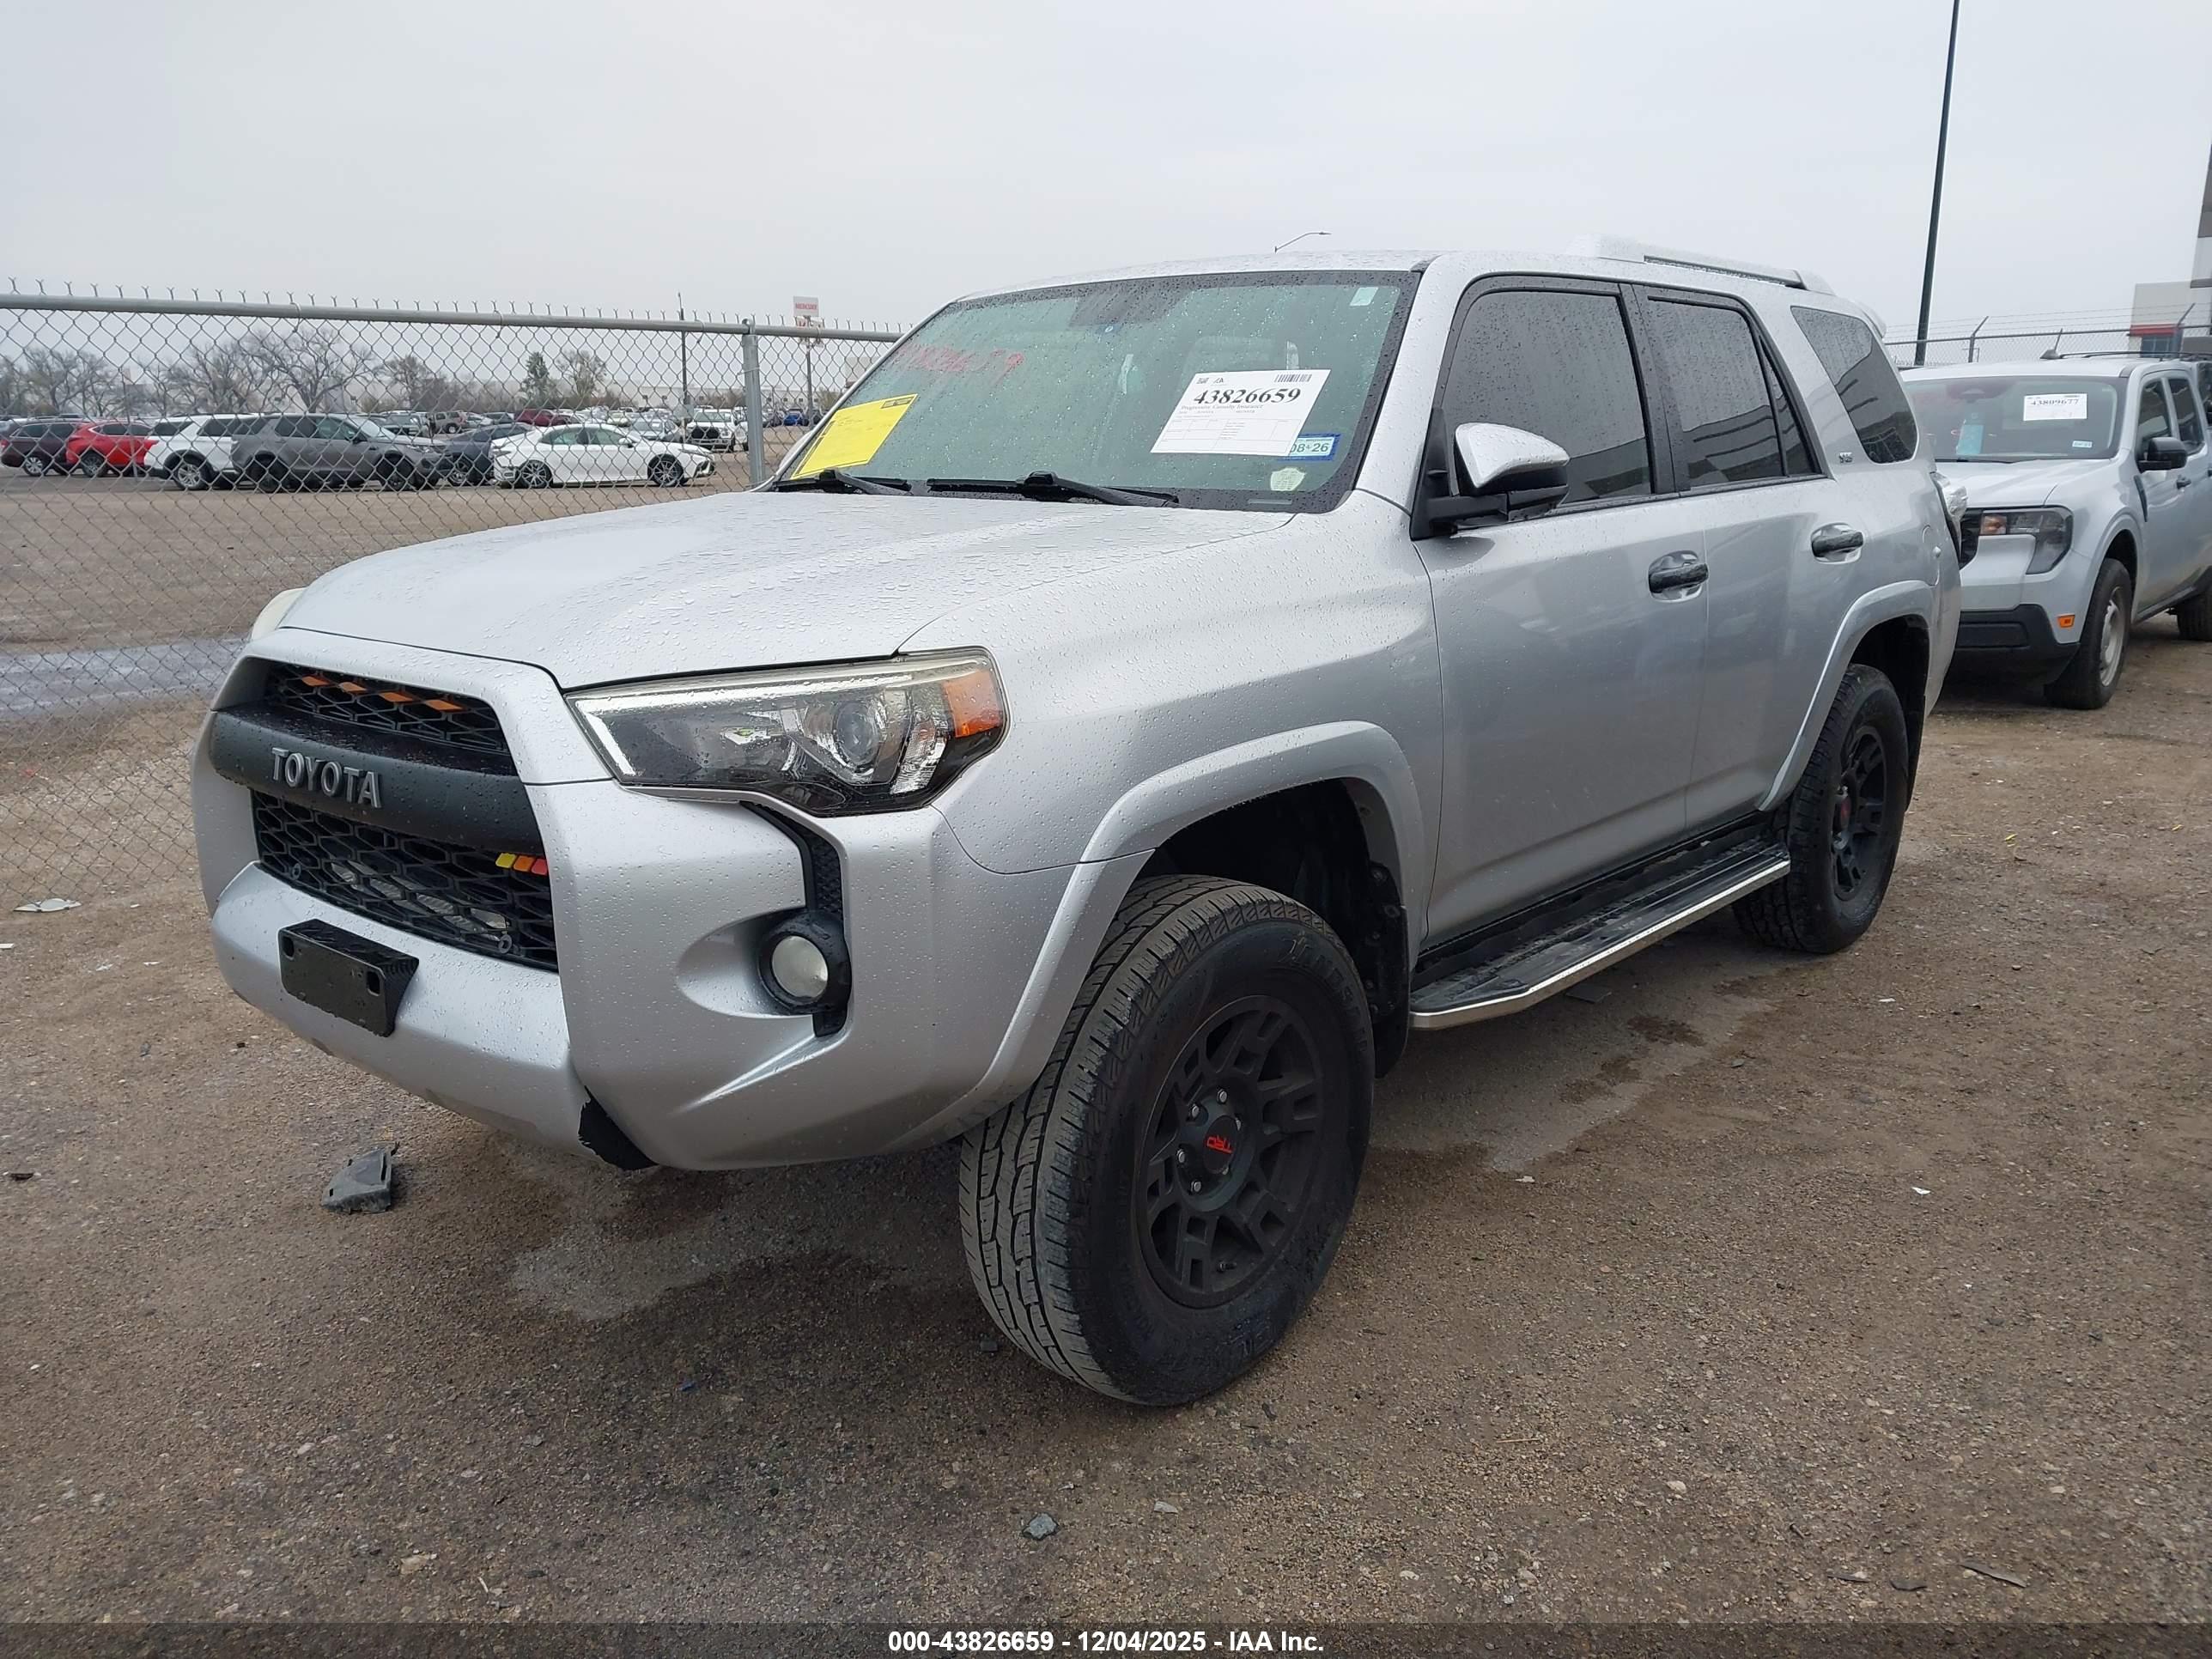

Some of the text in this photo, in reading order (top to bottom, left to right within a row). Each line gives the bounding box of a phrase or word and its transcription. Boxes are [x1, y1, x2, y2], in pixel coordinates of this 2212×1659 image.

[1194, 387, 1302, 404] 43826659
[1311, 442, 1330, 453] 26
[271, 747, 382, 808] TOYOTA
[1206, 1135, 1232, 1154] TRD
